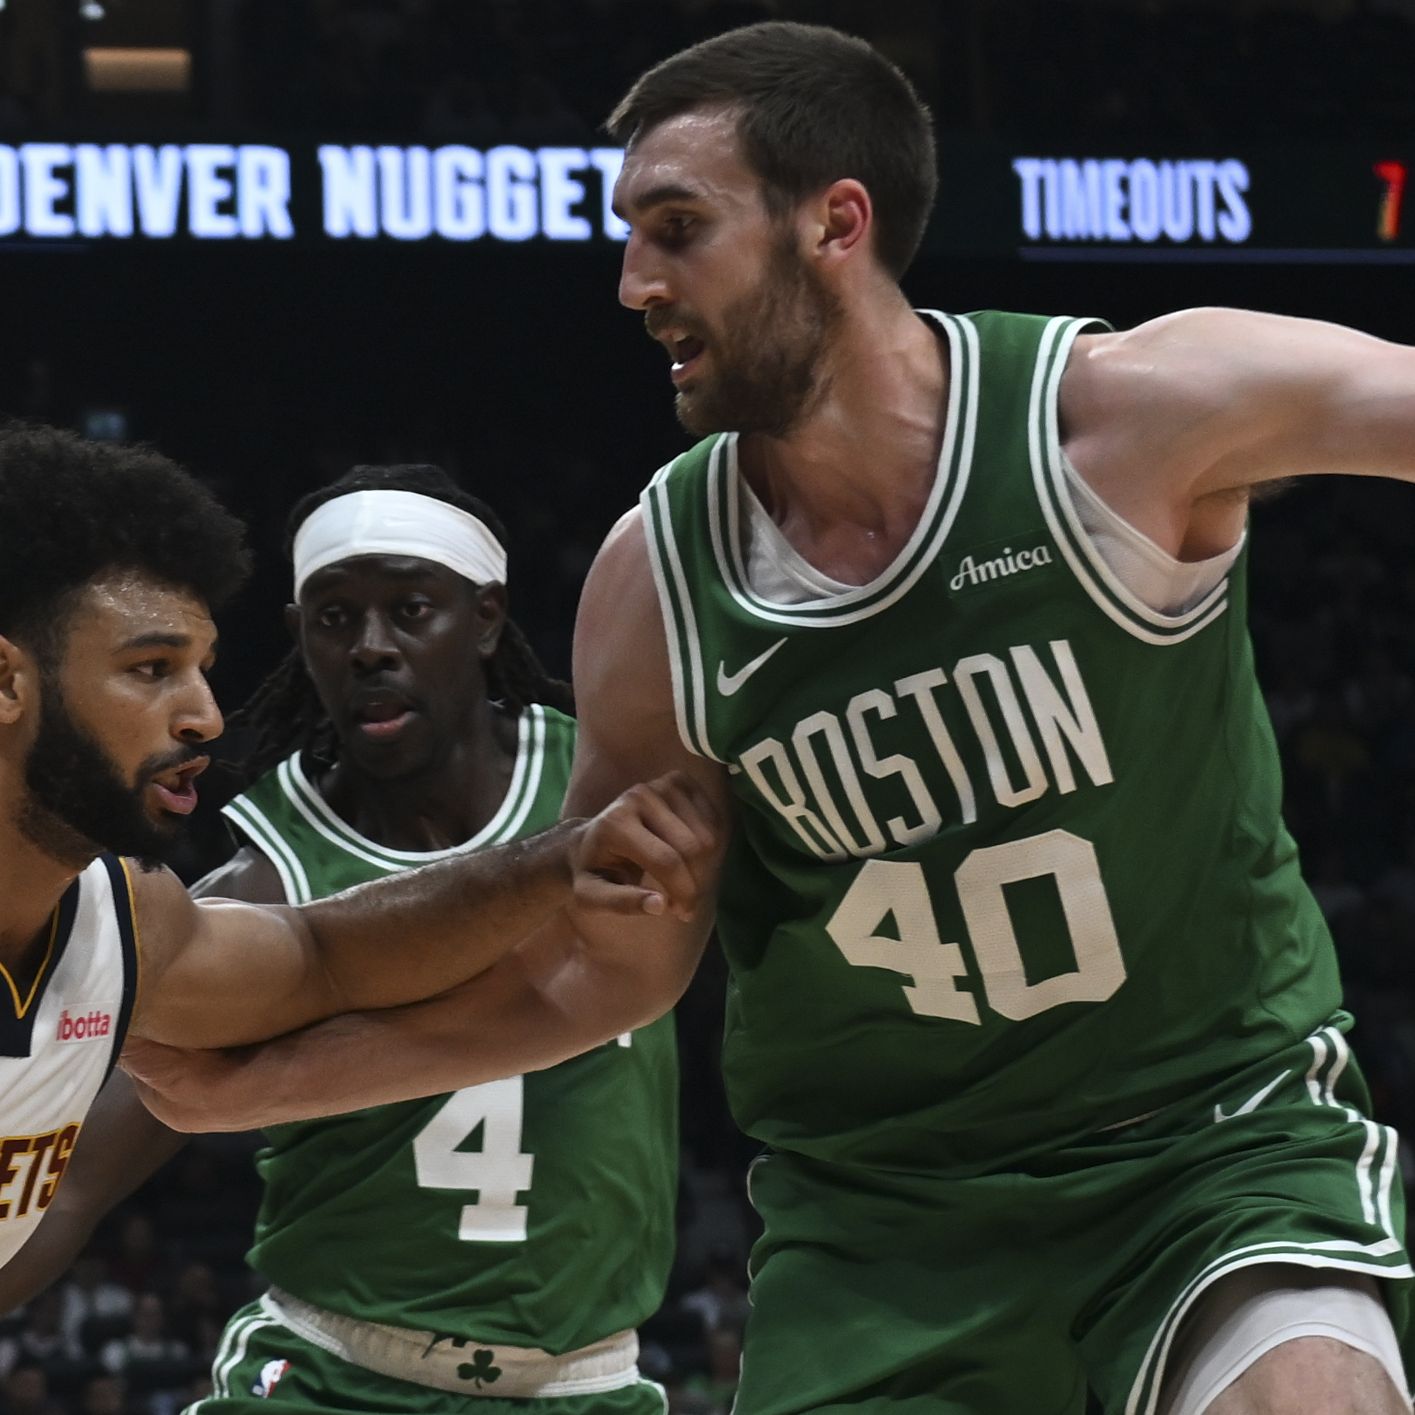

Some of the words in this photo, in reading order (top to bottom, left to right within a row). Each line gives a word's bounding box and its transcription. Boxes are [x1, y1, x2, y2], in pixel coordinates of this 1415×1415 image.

[1013, 157, 1251, 243] TIMEOUTS
[1374, 161, 1406, 241] 7
[949, 544, 1053, 592] Amica
[738, 639, 1115, 863] BOSTON
[824, 828, 1128, 1026] 40
[56, 1009, 112, 1041] ibotta
[412, 1073, 535, 1242] 4
